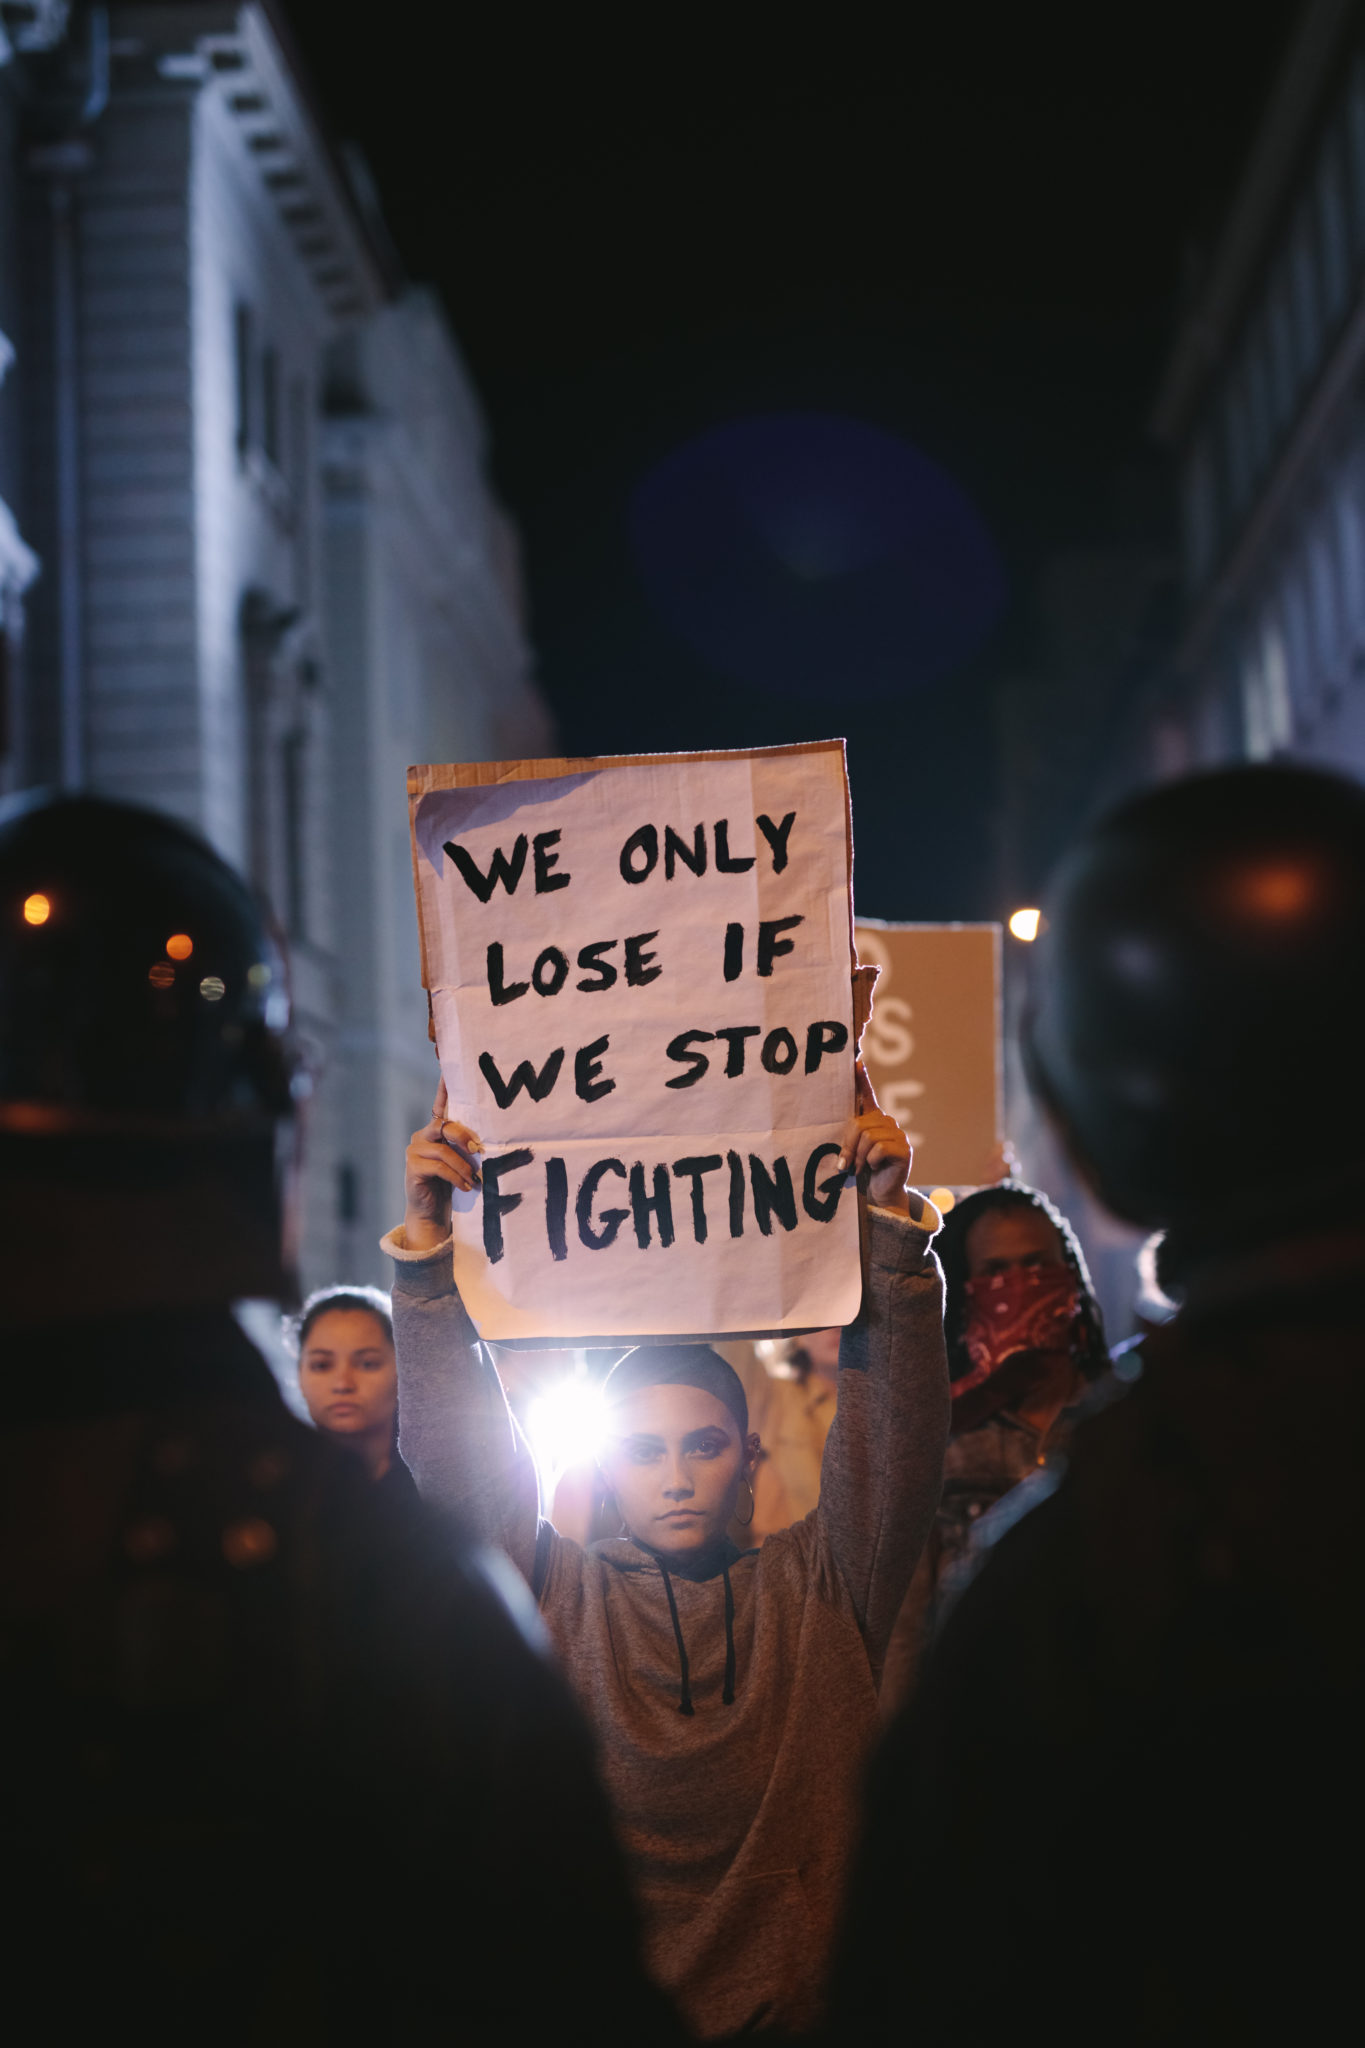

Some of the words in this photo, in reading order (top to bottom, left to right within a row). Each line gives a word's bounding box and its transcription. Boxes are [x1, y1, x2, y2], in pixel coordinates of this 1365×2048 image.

[442, 828, 571, 904] WE
[619, 811, 797, 885] ONLY
[486, 930, 663, 1007] LOSE
[723, 914, 806, 983] IF
[478, 1034, 617, 1110] WE
[665, 1020, 849, 1090] STOP
[481, 1142, 851, 1264] FIGHTING
